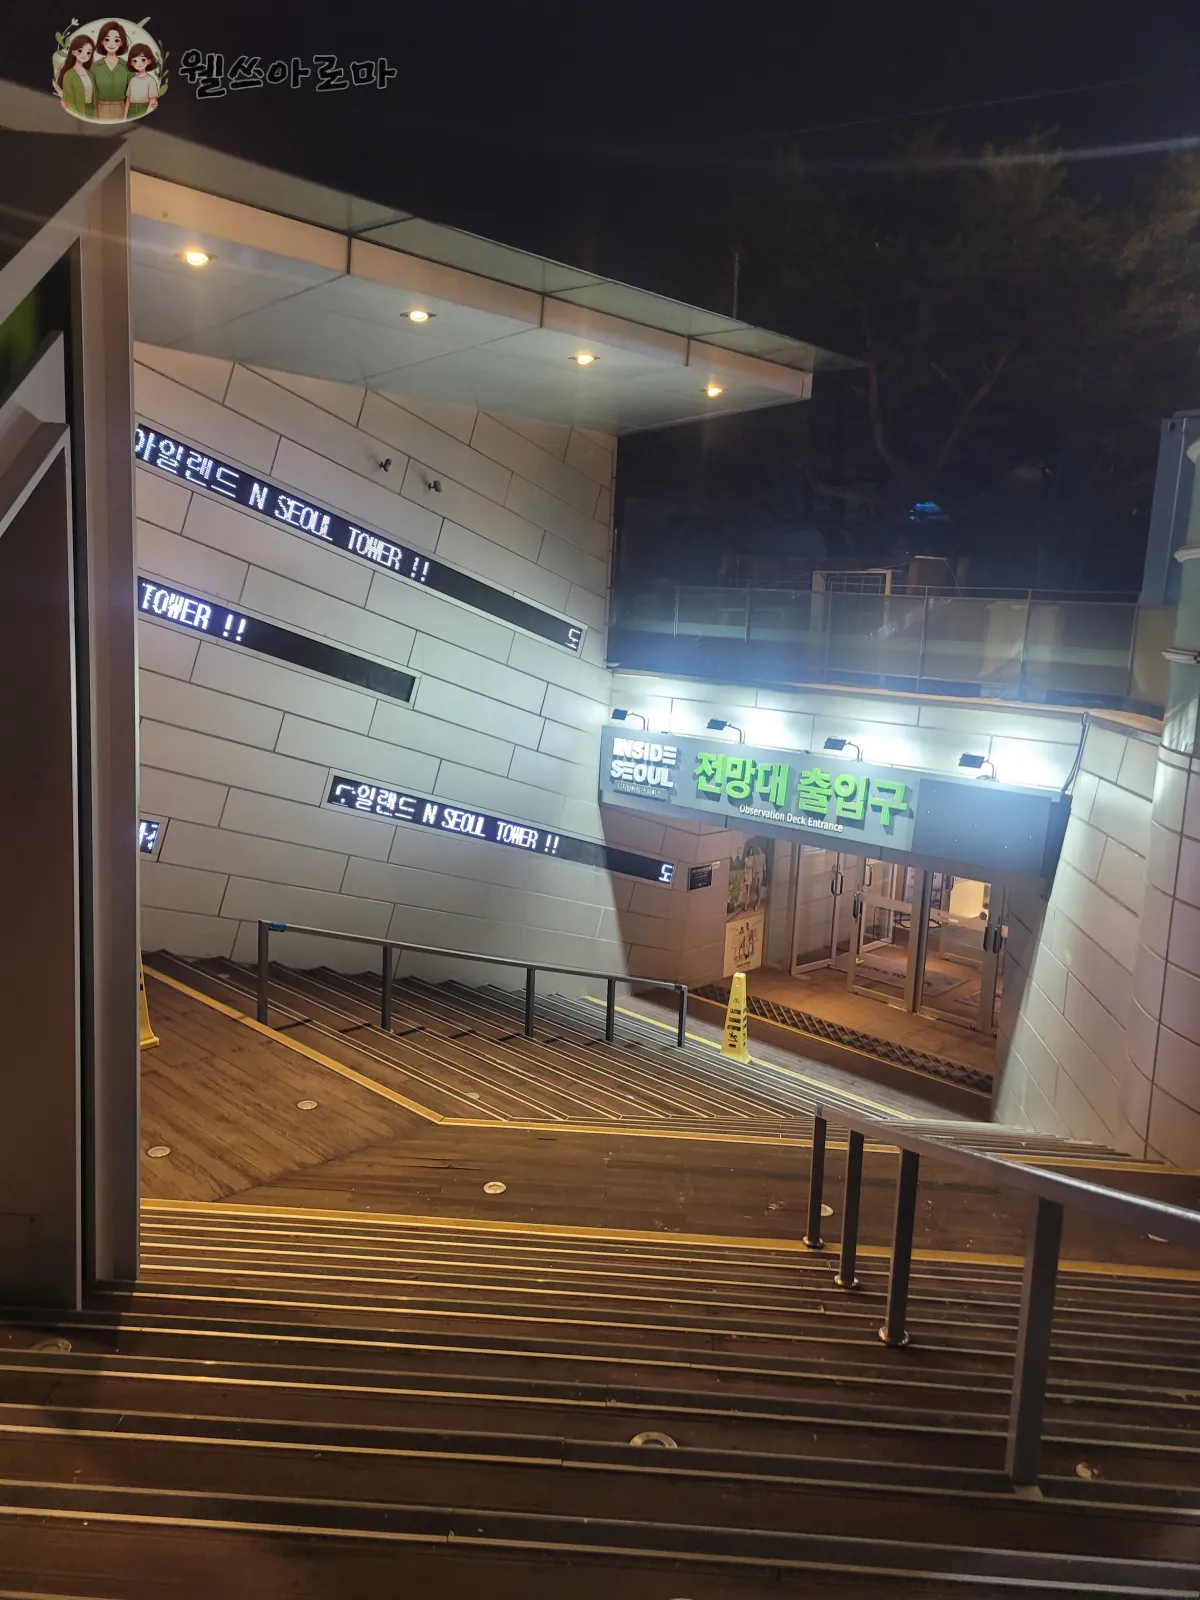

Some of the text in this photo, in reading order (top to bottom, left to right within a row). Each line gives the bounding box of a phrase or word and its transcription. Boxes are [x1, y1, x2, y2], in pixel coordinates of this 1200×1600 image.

[249, 482, 268, 510] N
[273, 494, 334, 541] SEOUL
[348, 526, 403, 570] TOWER
[410, 556, 430, 582] !!
[141, 582, 247, 641] TOWER !!
[610, 759, 674, 788] SEOUL
[612, 737, 678, 766] INSIDE
[693, 752, 908, 826] 전망대 출입구
[422, 801, 437, 825] N
[441, 808, 487, 838] SEOUL
[496, 820, 539, 849] TOWER
[543, 833, 560, 854] !!
[739, 804, 844, 833] Observation Deck Entrance
